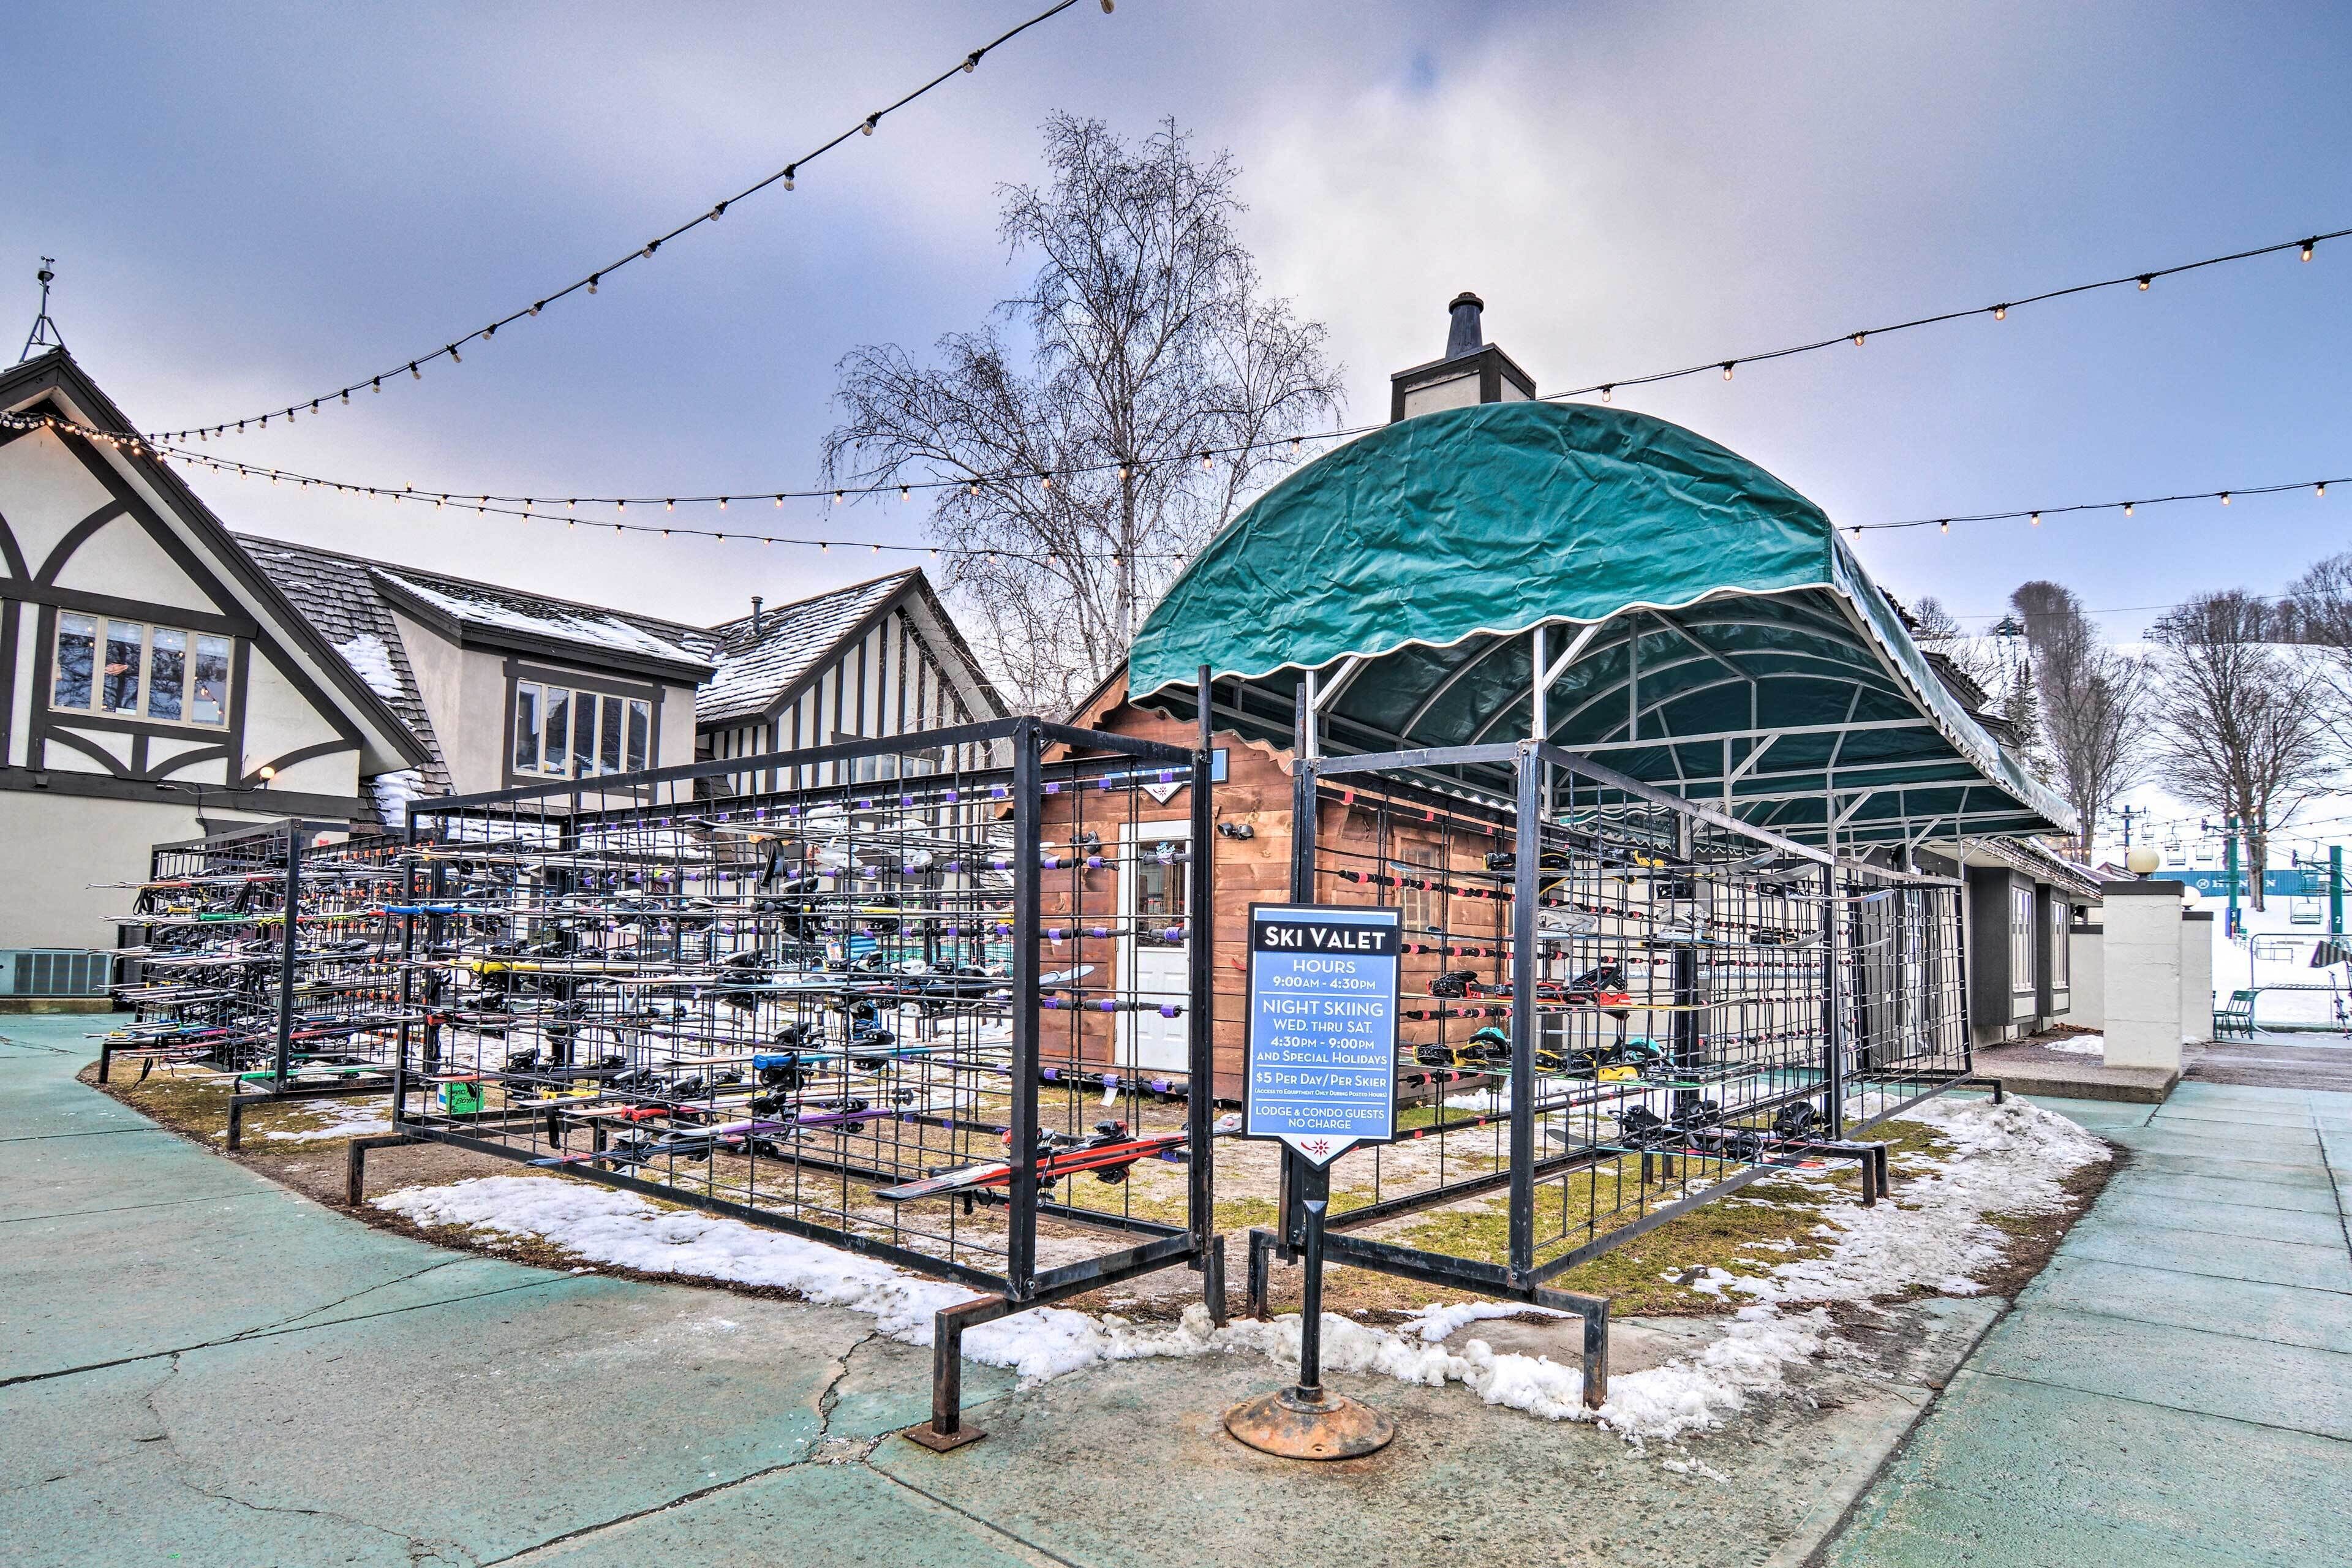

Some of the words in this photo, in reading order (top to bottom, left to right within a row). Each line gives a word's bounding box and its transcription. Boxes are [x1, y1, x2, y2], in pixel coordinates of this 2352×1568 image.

[2212, 879, 2276, 888] HNN
[1264, 925, 1302, 946] SKI
[1310, 927, 1386, 950] VALET
[1292, 959, 1356, 974] HOURS
[1262, 999, 1320, 1015] NIGHT
[1323, 1001, 1384, 1017] SKIING
[1273, 1019, 1309, 1031] WED.
[1311, 1021, 1343, 1032] THRU
[1347, 1020, 1373, 1033] SAT.
[1256, 1072, 1273, 1084] $5
[1255, 1106, 1292, 1117] LODGE
[1302, 1107, 1343, 1118] CONDO
[1344, 1108, 1384, 1119] GUESTS
[1288, 1118, 1306, 1128] NO
[1307, 1119, 1351, 1129] CHARGE
